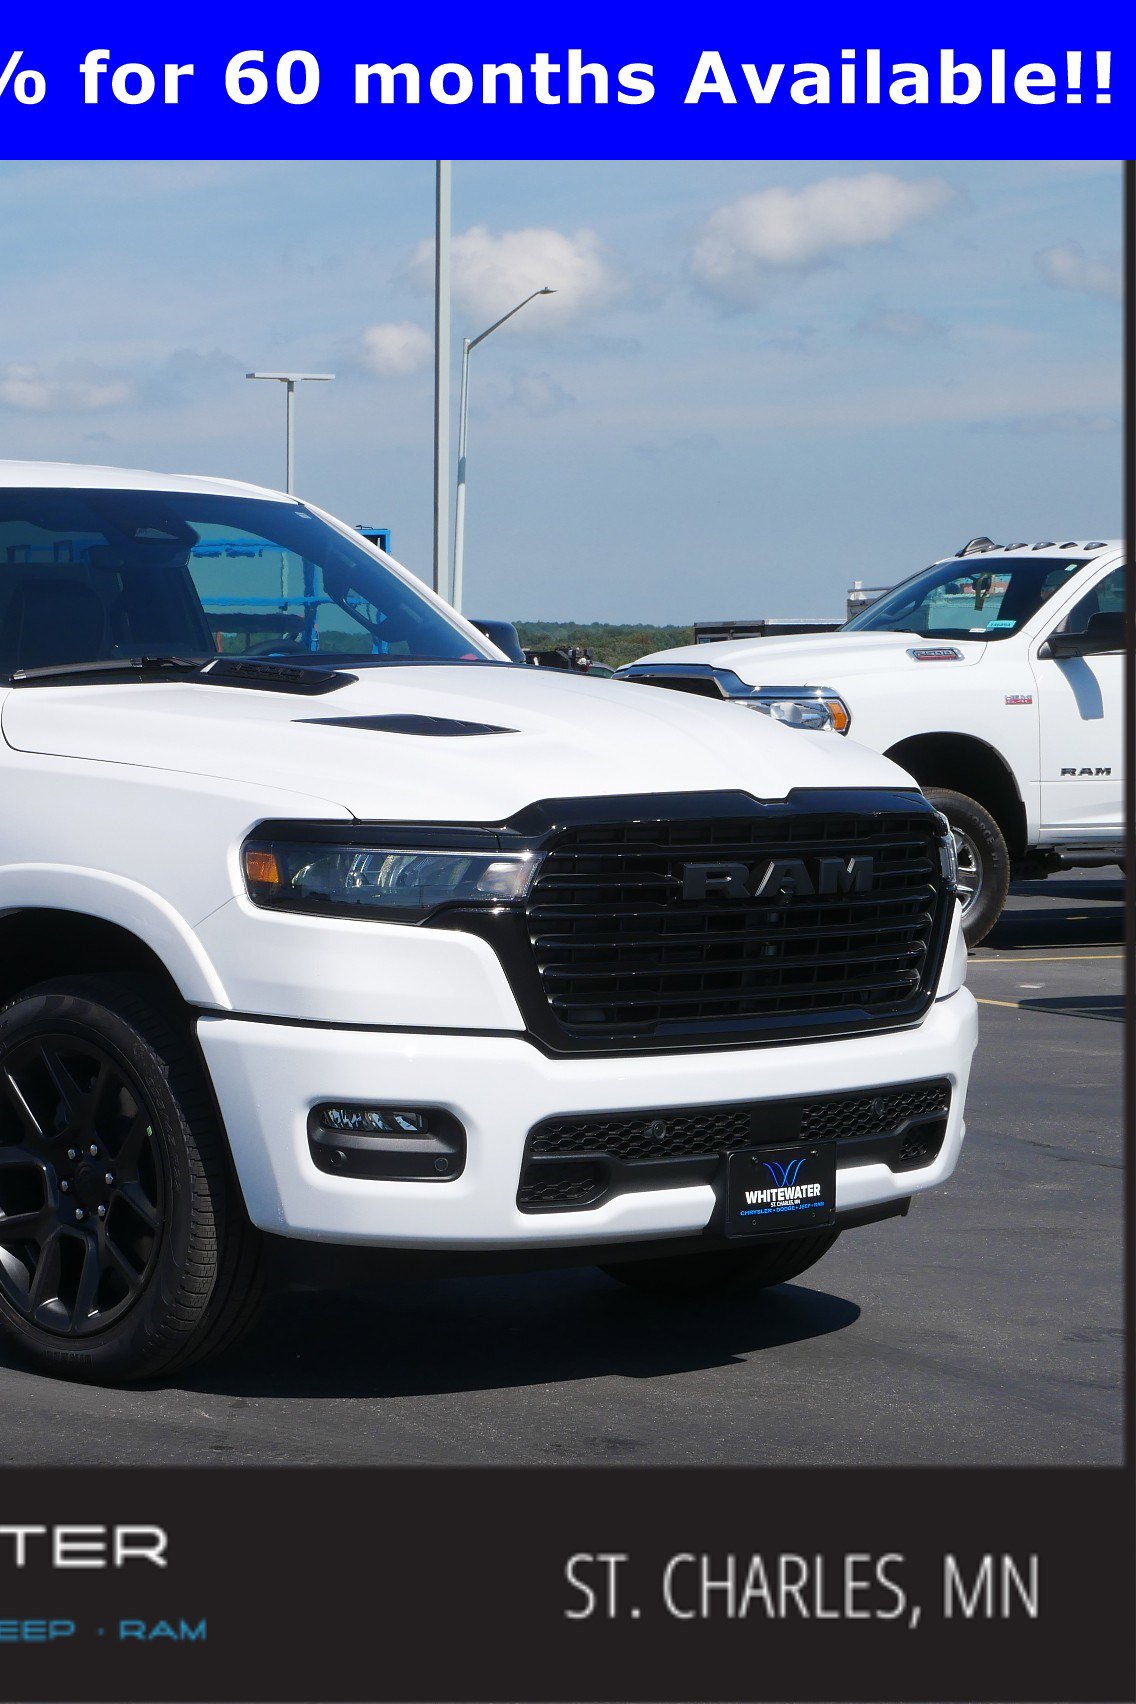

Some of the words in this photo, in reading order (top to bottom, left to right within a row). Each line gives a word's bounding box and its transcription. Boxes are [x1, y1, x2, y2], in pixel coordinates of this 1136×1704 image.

[1061, 767, 1112, 777] RAM
[683, 856, 874, 900] RAM
[745, 1184, 821, 1205] WHITEWATER
[740, 1208, 772, 1216] CHRYSLER
